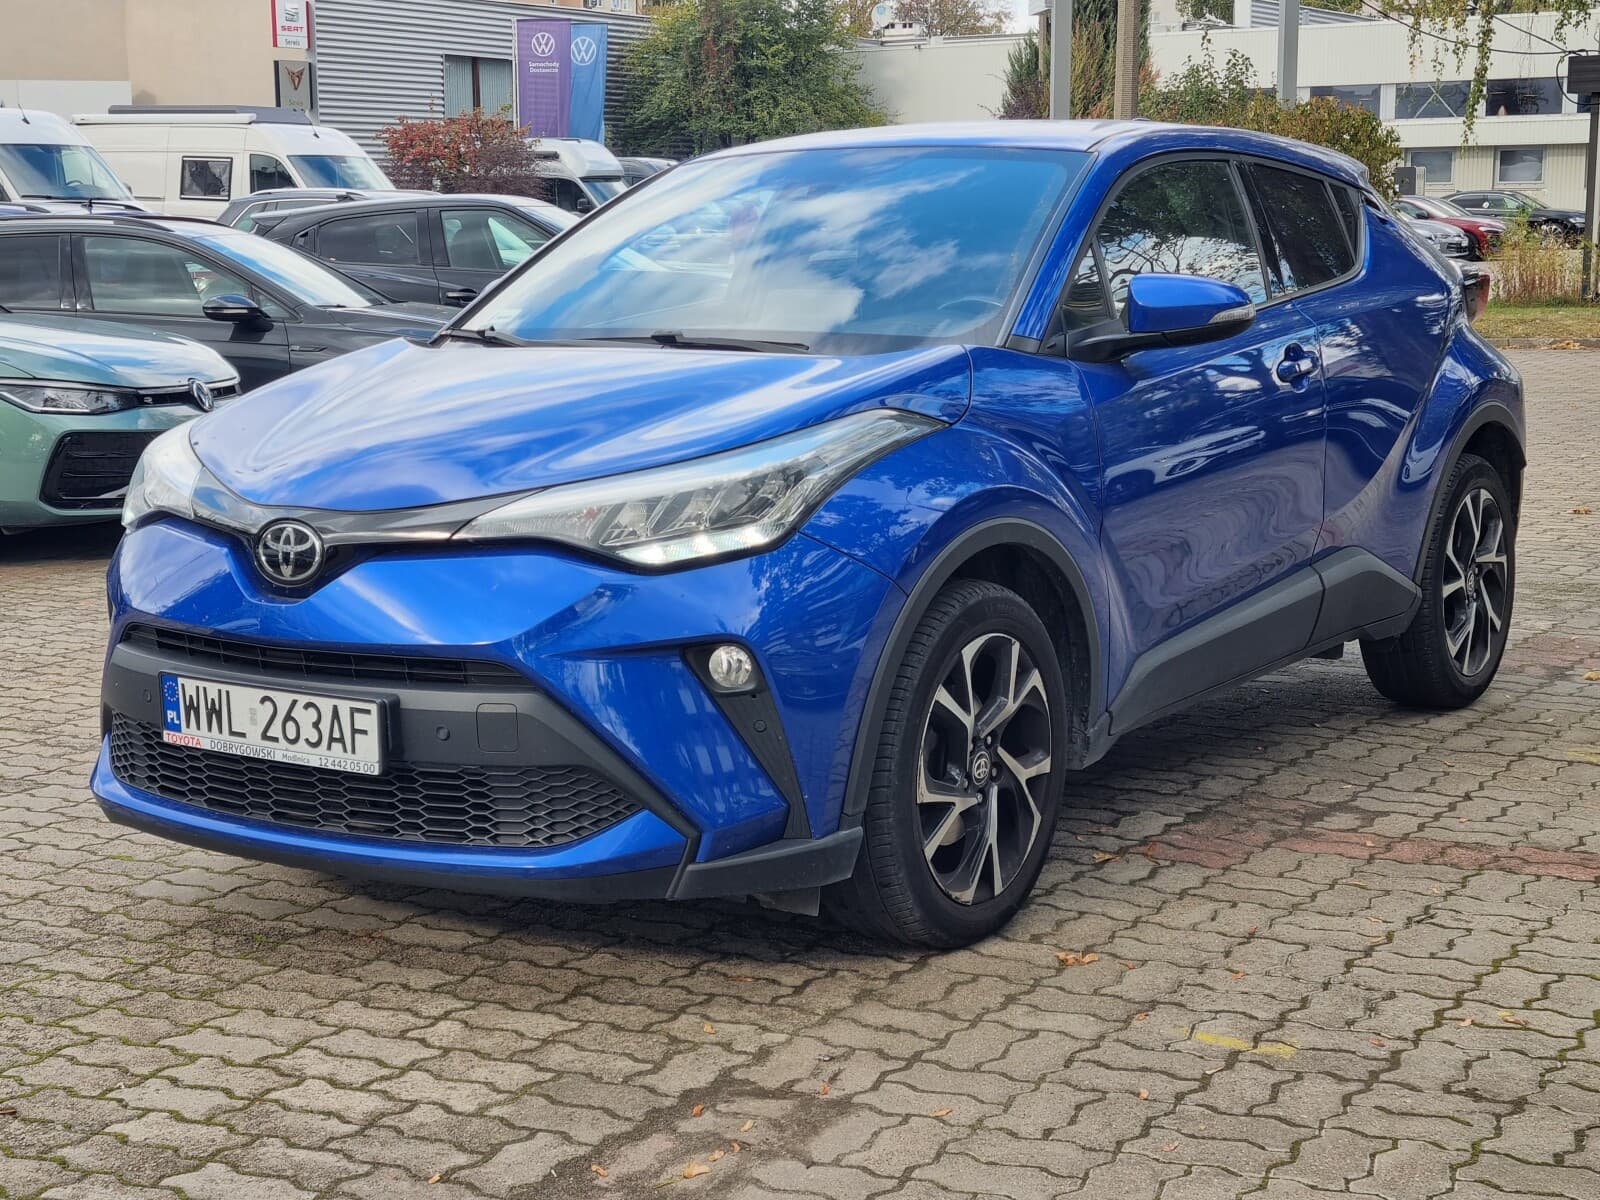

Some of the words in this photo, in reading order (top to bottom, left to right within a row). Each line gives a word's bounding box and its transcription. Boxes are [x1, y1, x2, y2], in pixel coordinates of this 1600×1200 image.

[166, 710, 180, 724] PL
[181, 683, 247, 739] WWL
[259, 695, 372, 755] 263AF
[166, 732, 201, 747] TOYOTA
[209, 740, 276, 760] DOBRYGOWSKI
